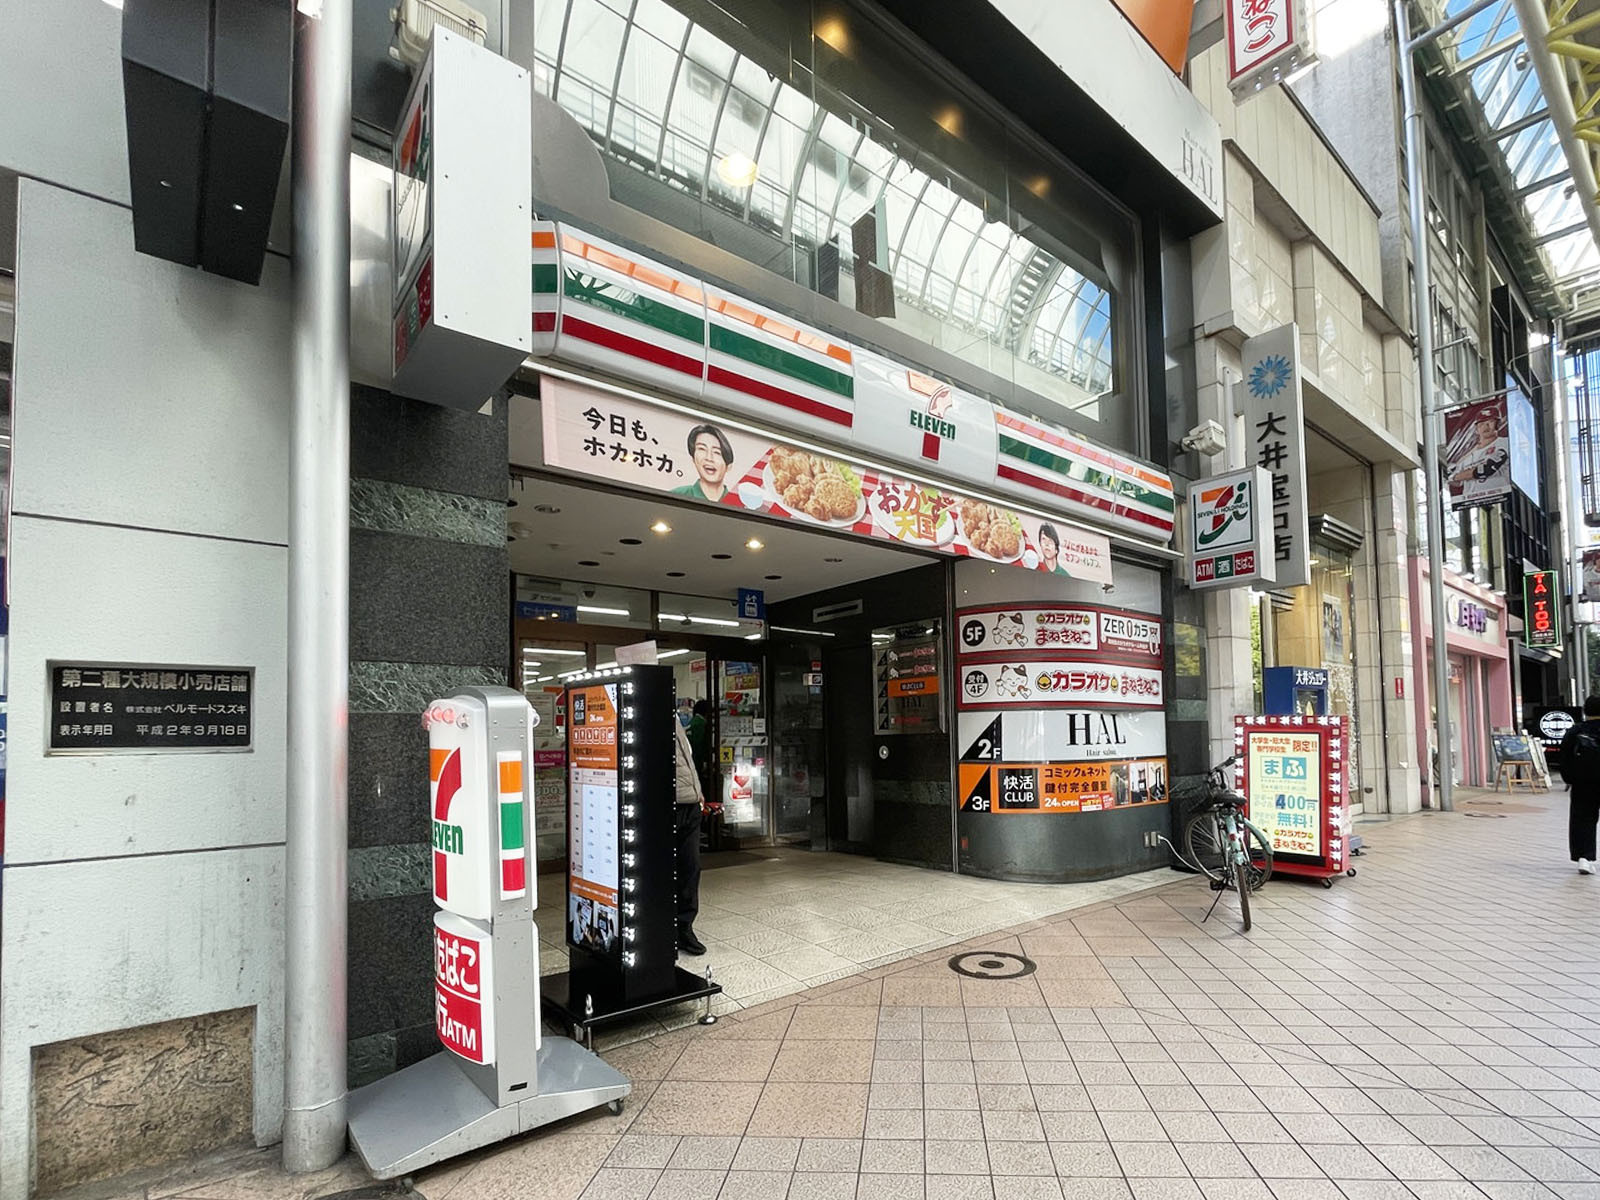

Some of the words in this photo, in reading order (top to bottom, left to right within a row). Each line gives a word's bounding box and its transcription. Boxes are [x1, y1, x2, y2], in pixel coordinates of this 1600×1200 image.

[1181, 136, 1218, 206] HAL
[582, 406, 660, 445] 今日も、
[583, 436, 685, 478] ホカホカ。
[892, 509, 939, 542] 天国
[1196, 560, 1213, 578] ATM
[1217, 559, 1231, 575] 酒
[1235, 556, 1255, 573] たばこ
[1045, 613, 1083, 624] カラオケ
[966, 624, 983, 642] 5F
[1035, 627, 1092, 646] まねきねこ
[62, 669, 248, 692] 第二種大規模小売店舗
[967, 674, 985, 684] 受付
[1052, 671, 1110, 691] カラオケ
[1120, 673, 1160, 696] まねきねこ
[1295, 670, 1326, 687] 大井ジュエリー
[969, 684, 984, 694] 4F
[60, 701, 113, 713] 設置者名
[59, 724, 113, 736] 表示年月日
[136, 724, 247, 736] 平成2年3月18日
[1066, 713, 1127, 746] HAL
[977, 738, 1002, 760] 2F
[1086, 749, 1101, 757] Hair
[1045, 766, 1107, 778] コミック&ネット
[1264, 759, 1305, 777] まふ
[1003, 775, 1034, 790] 快活
[972, 796, 990, 811] 3F
[1004, 791, 1035, 803] CLUB
[1062, 799, 1080, 807] OPEN
[1277, 812, 1313, 828] 無料!
[1280, 830, 1308, 838] カラオケ
[1273, 838, 1315, 852] まねきねこ
